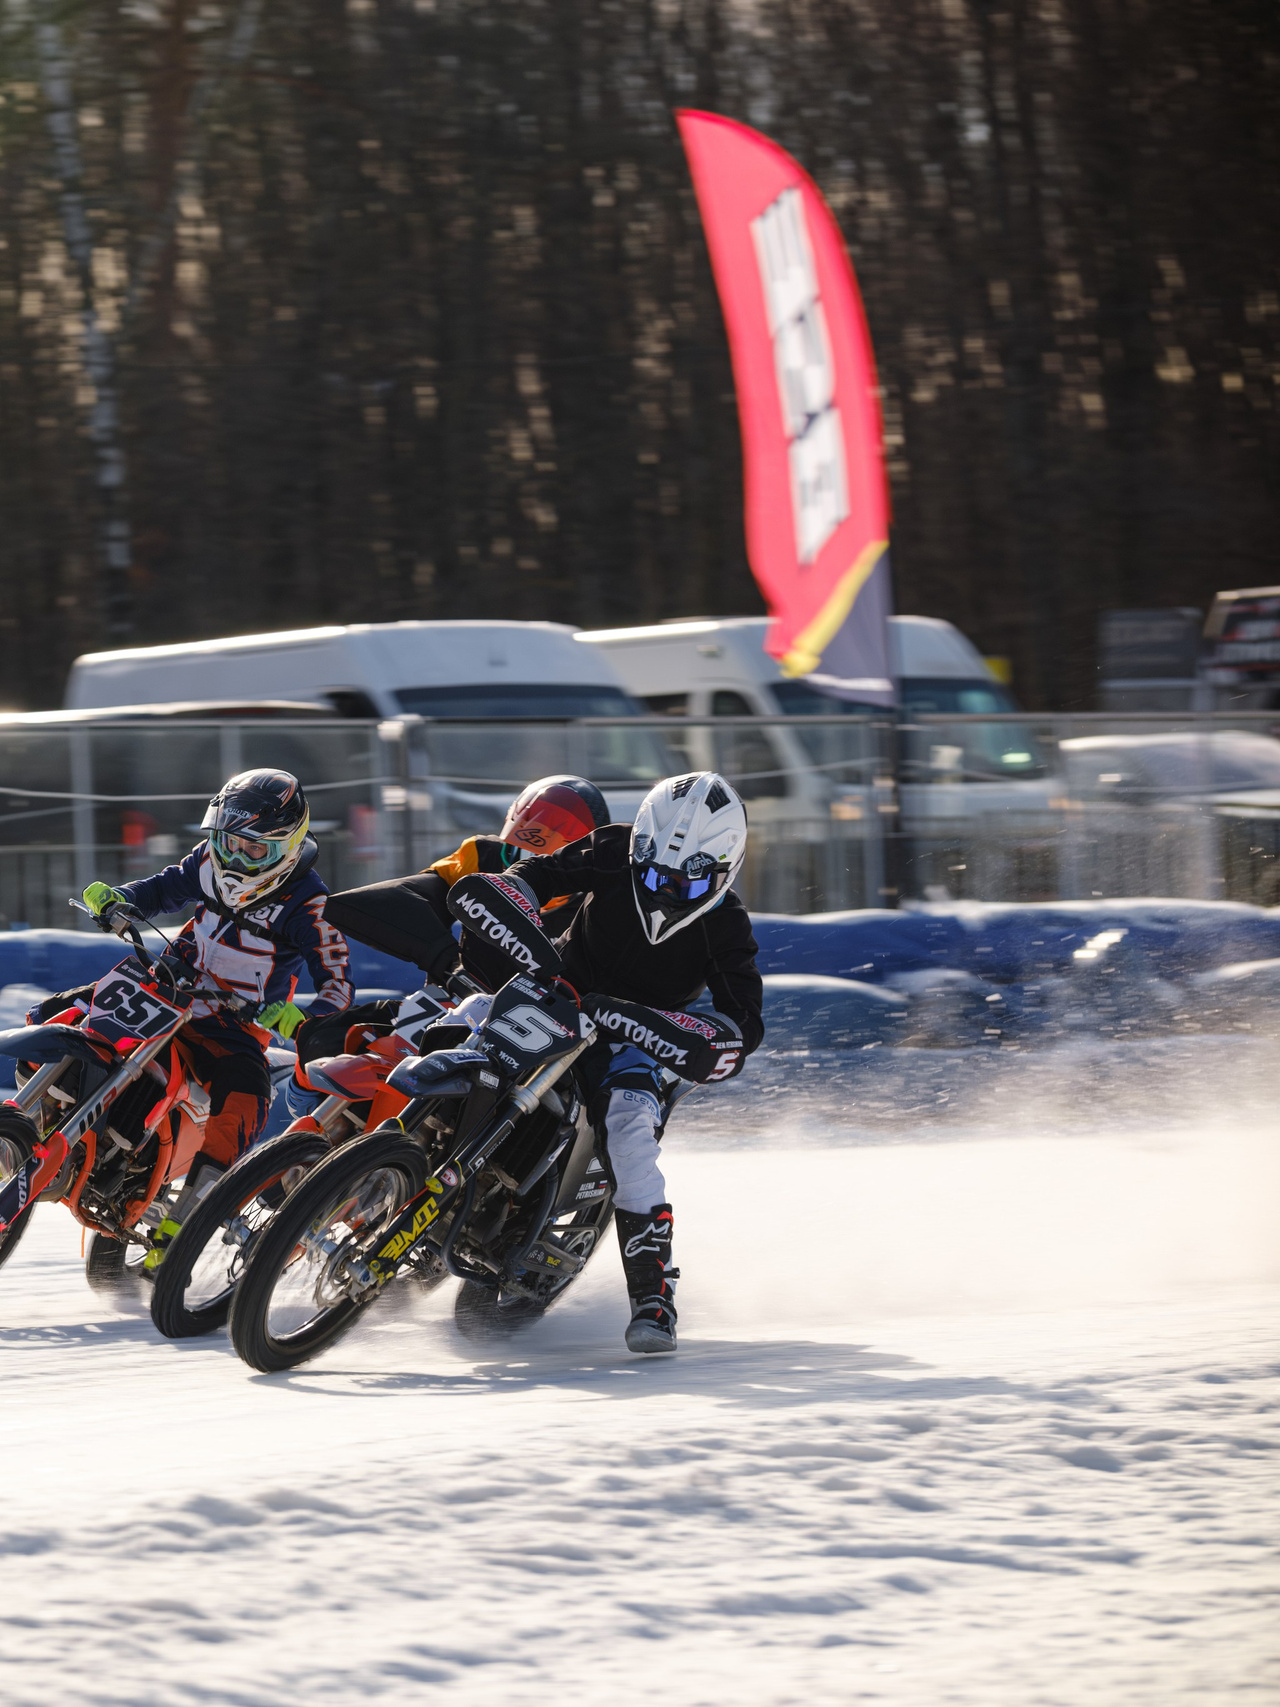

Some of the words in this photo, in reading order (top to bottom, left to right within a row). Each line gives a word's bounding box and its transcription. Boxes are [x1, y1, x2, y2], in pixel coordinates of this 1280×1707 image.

[686, 854, 713, 872] Airoh
[456, 893, 541, 977] MOTOKIDZ
[93, 980, 179, 1040] 651
[486, 1004, 570, 1053] 5
[482, 1042, 519, 1069] MOKIDZ
[593, 1008, 689, 1065] MOTOKIDZ
[705, 1050, 740, 1081] 5
